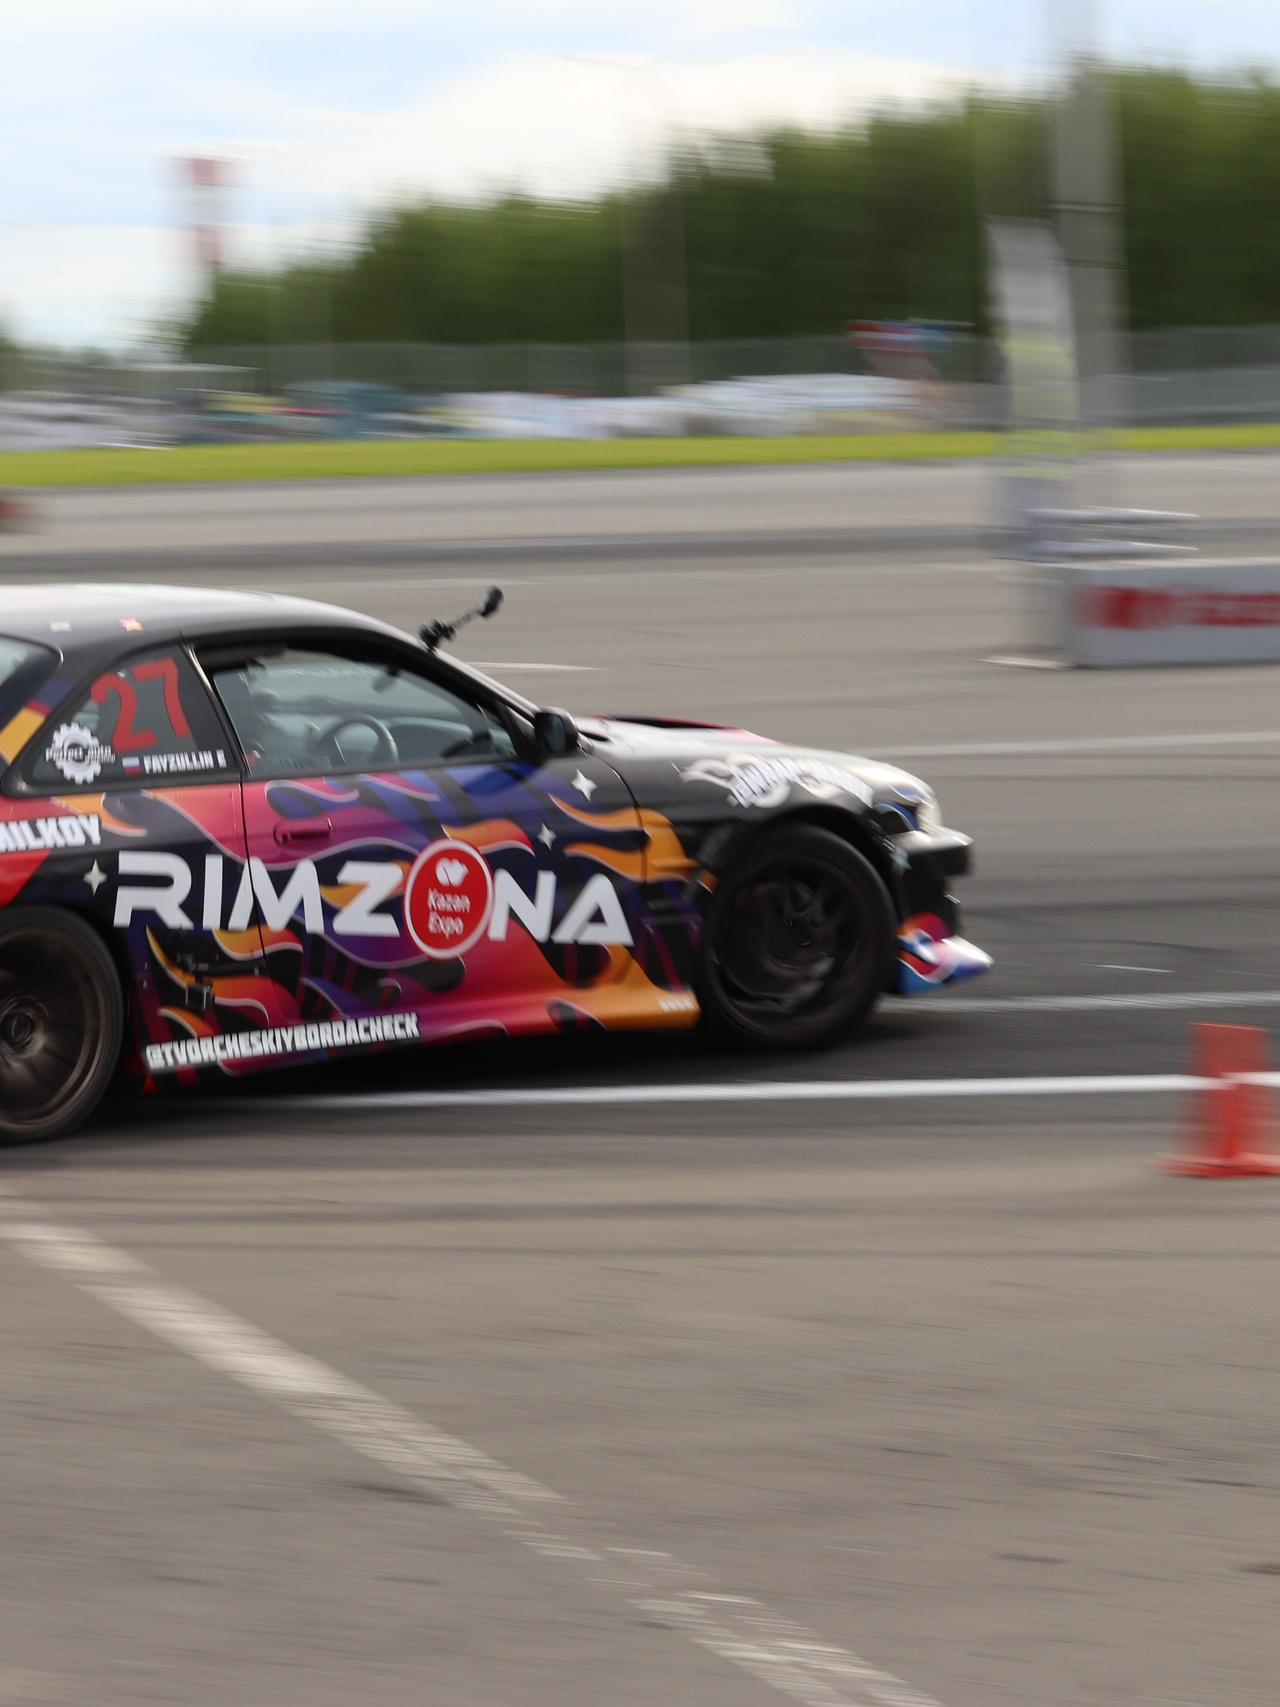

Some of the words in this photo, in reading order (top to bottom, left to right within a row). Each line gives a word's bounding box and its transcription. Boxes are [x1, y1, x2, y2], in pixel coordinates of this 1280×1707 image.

[91, 657, 192, 753] 27
[143, 751, 215, 774] FAYZULLIN
[427, 888, 471, 913] Kazan
[427, 911, 464, 939] Expo
